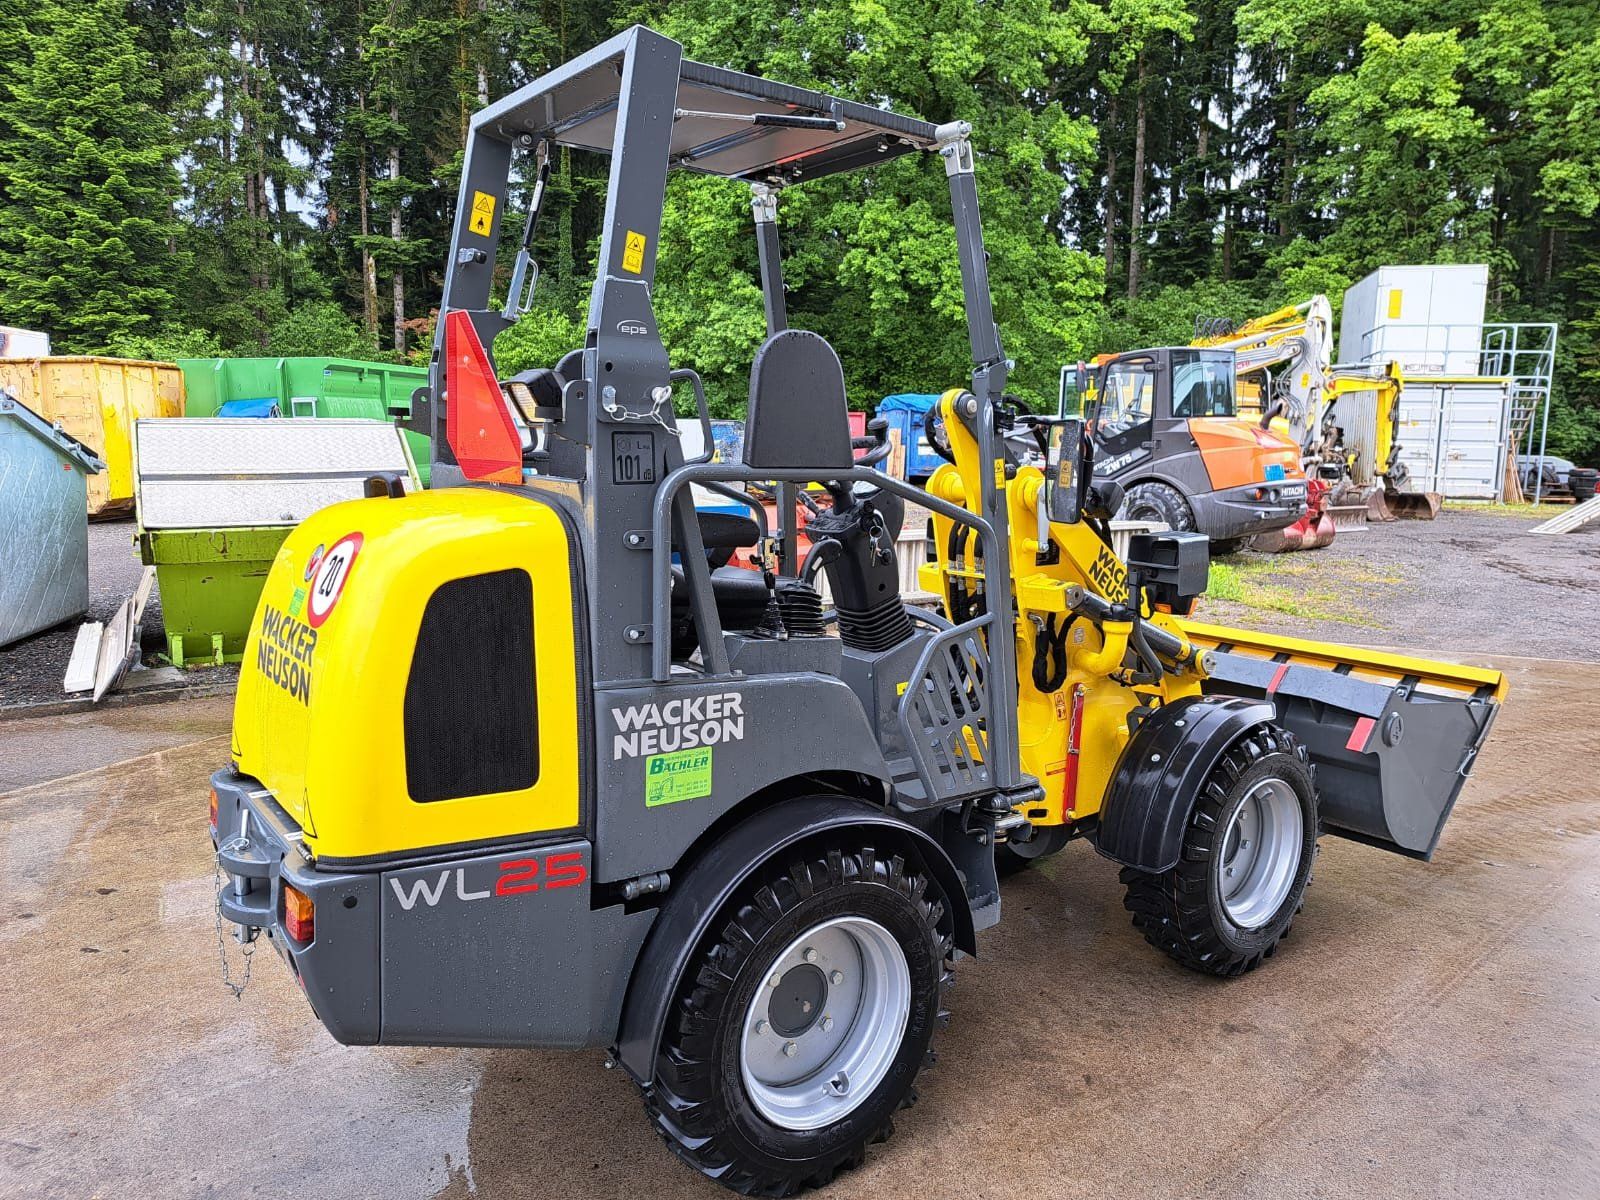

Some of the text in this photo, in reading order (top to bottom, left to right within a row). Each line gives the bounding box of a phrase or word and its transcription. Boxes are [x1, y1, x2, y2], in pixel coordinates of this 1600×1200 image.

[620, 325, 648, 335] eps
[616, 454, 641, 481] 101
[1104, 453, 1132, 475] ZW75
[1281, 486, 1304, 497] HITACHI
[318, 555, 345, 597] 20
[1089, 560, 1129, 604] NEUS
[1098, 544, 1136, 599] WACK
[262, 604, 318, 667] WACKER
[257, 638, 311, 707] NEUSON
[611, 692, 744, 732] WACKER
[614, 716, 744, 760] NEUSON
